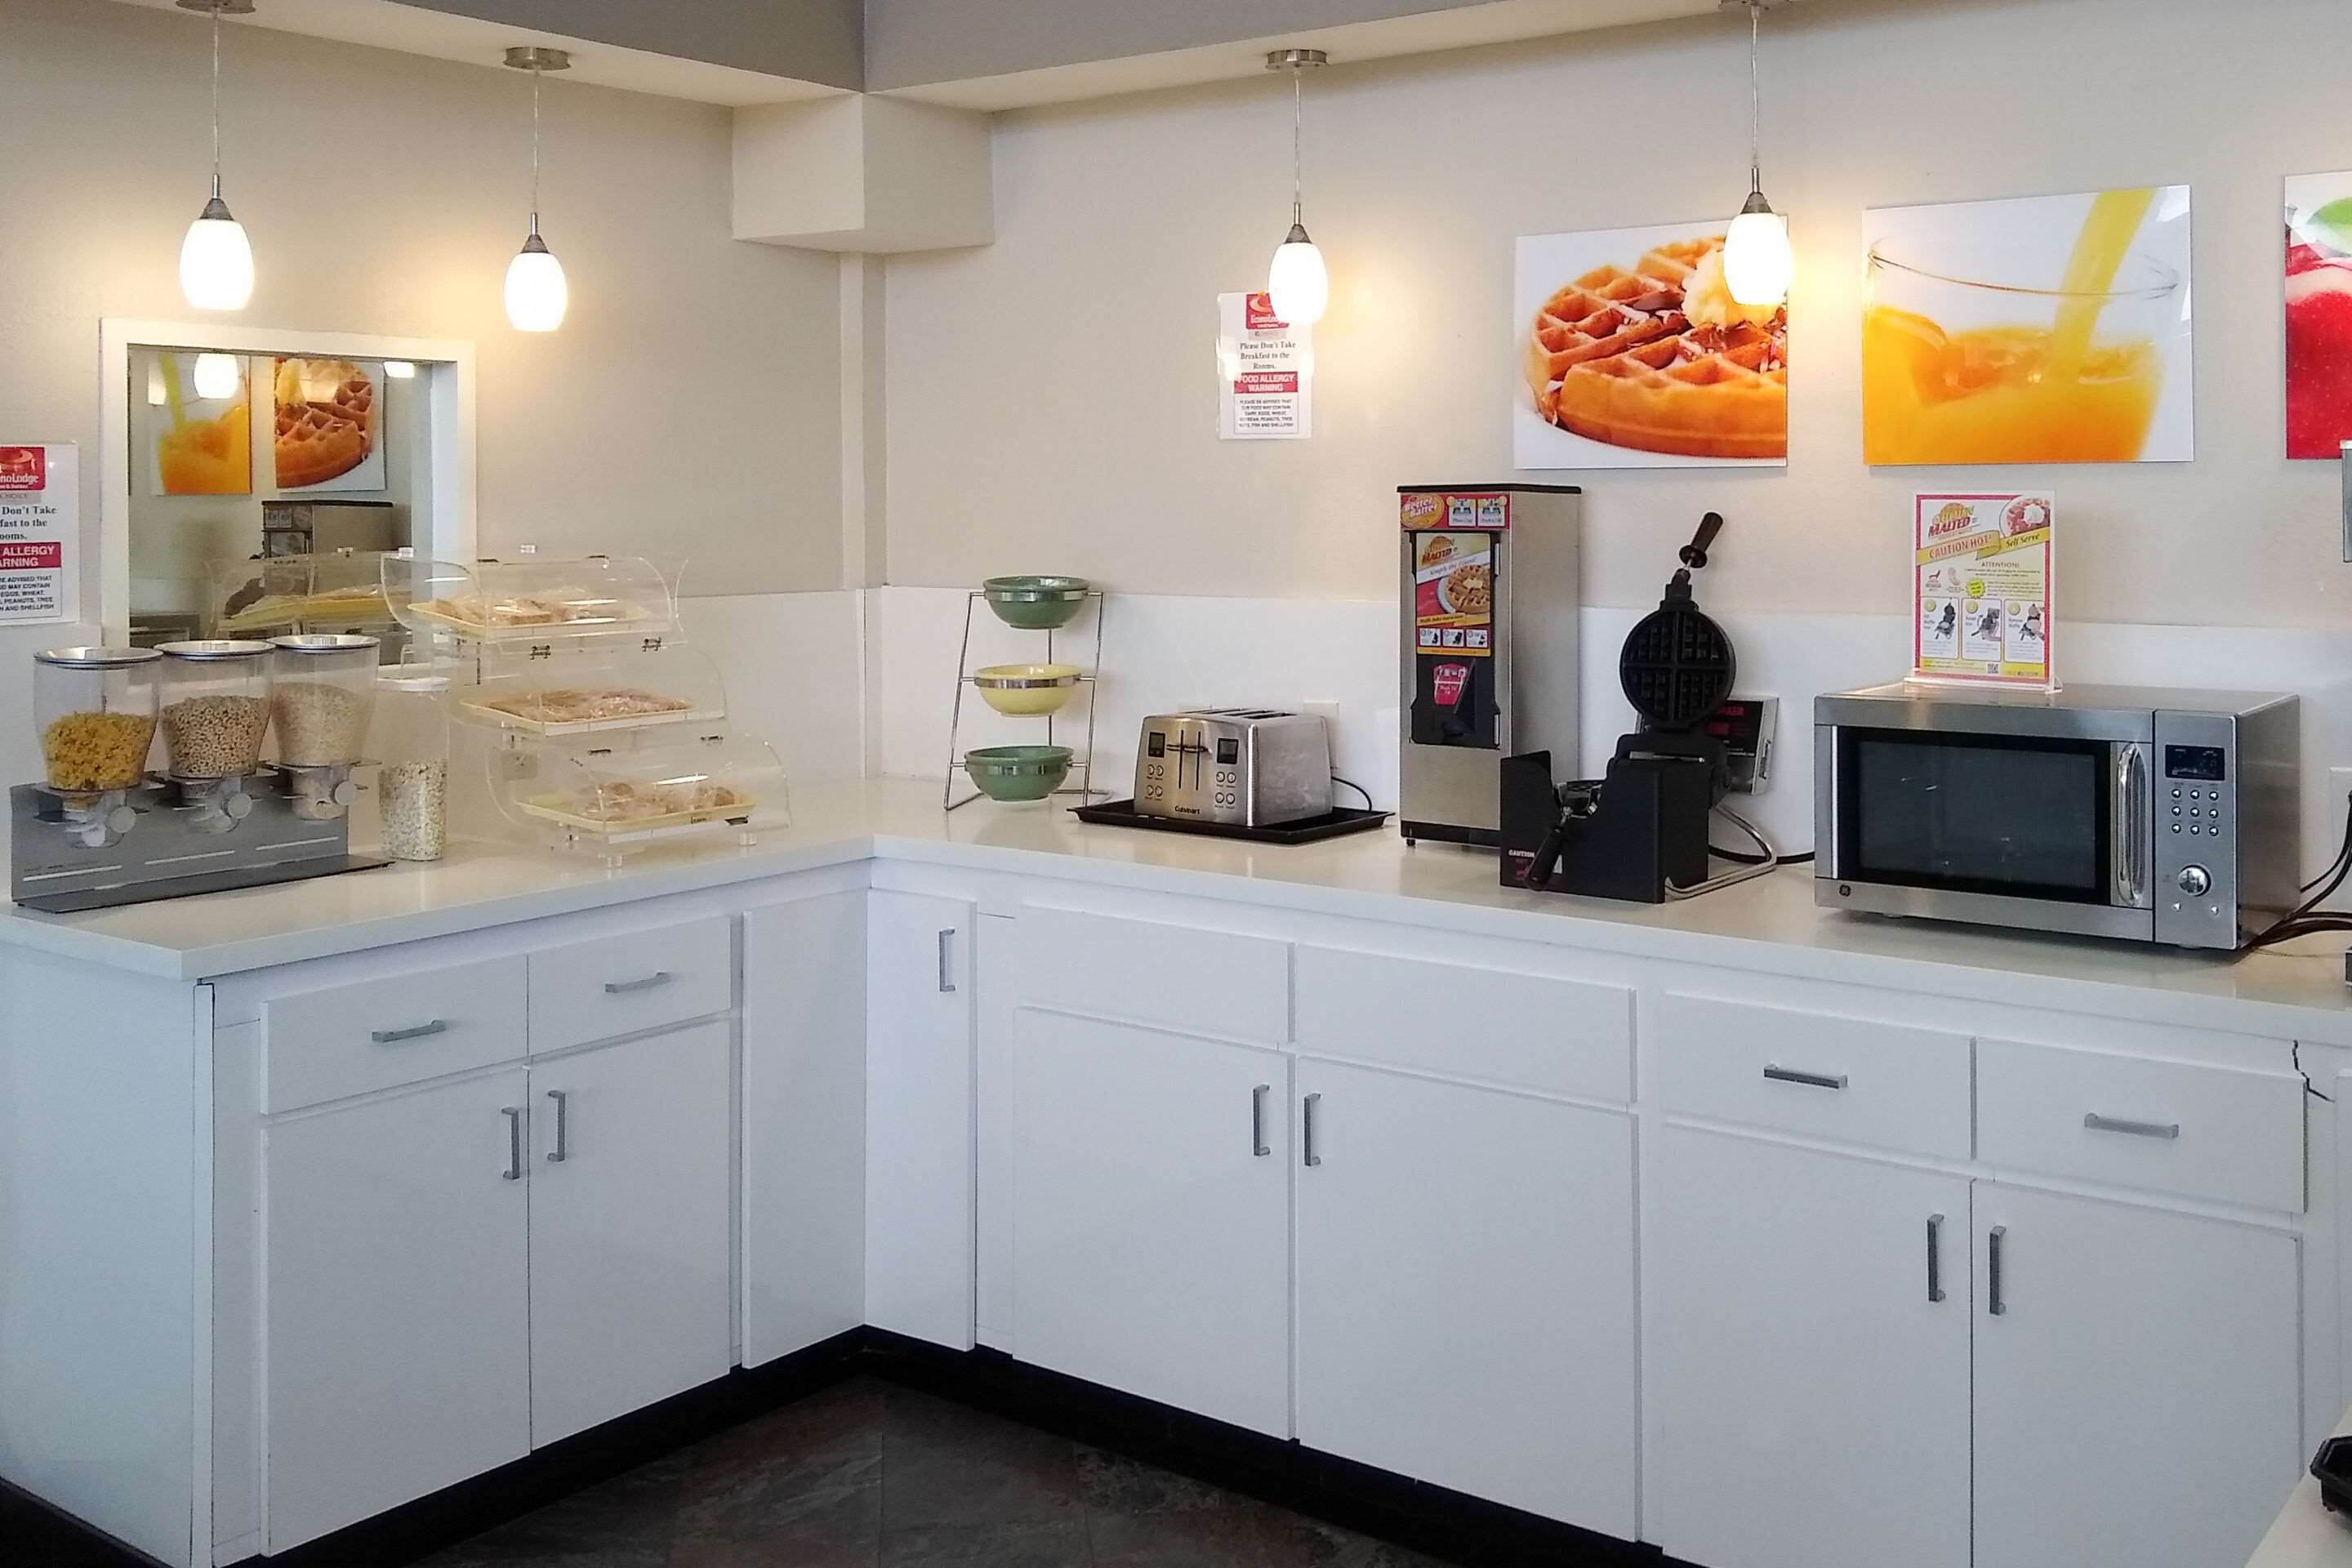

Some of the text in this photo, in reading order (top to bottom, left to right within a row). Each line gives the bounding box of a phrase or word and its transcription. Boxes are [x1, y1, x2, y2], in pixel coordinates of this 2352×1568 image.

[1259, 374, 1295, 382] ALLERGY
[1248, 383, 1284, 392] WARNING
[2, 506, 57, 514] Don't Take
[0, 519, 17, 528] fast
[33, 519, 47, 527] the
[1928, 516, 1971, 537] MALTED
[2006, 532, 2040, 549] Self Serve
[2, 546, 55, 556] ALLERGY
[1929, 541, 1969, 559] CAUTION
[1174, 805, 1200, 815] Cuisinart
[1508, 849, 1535, 858] CAUTION
